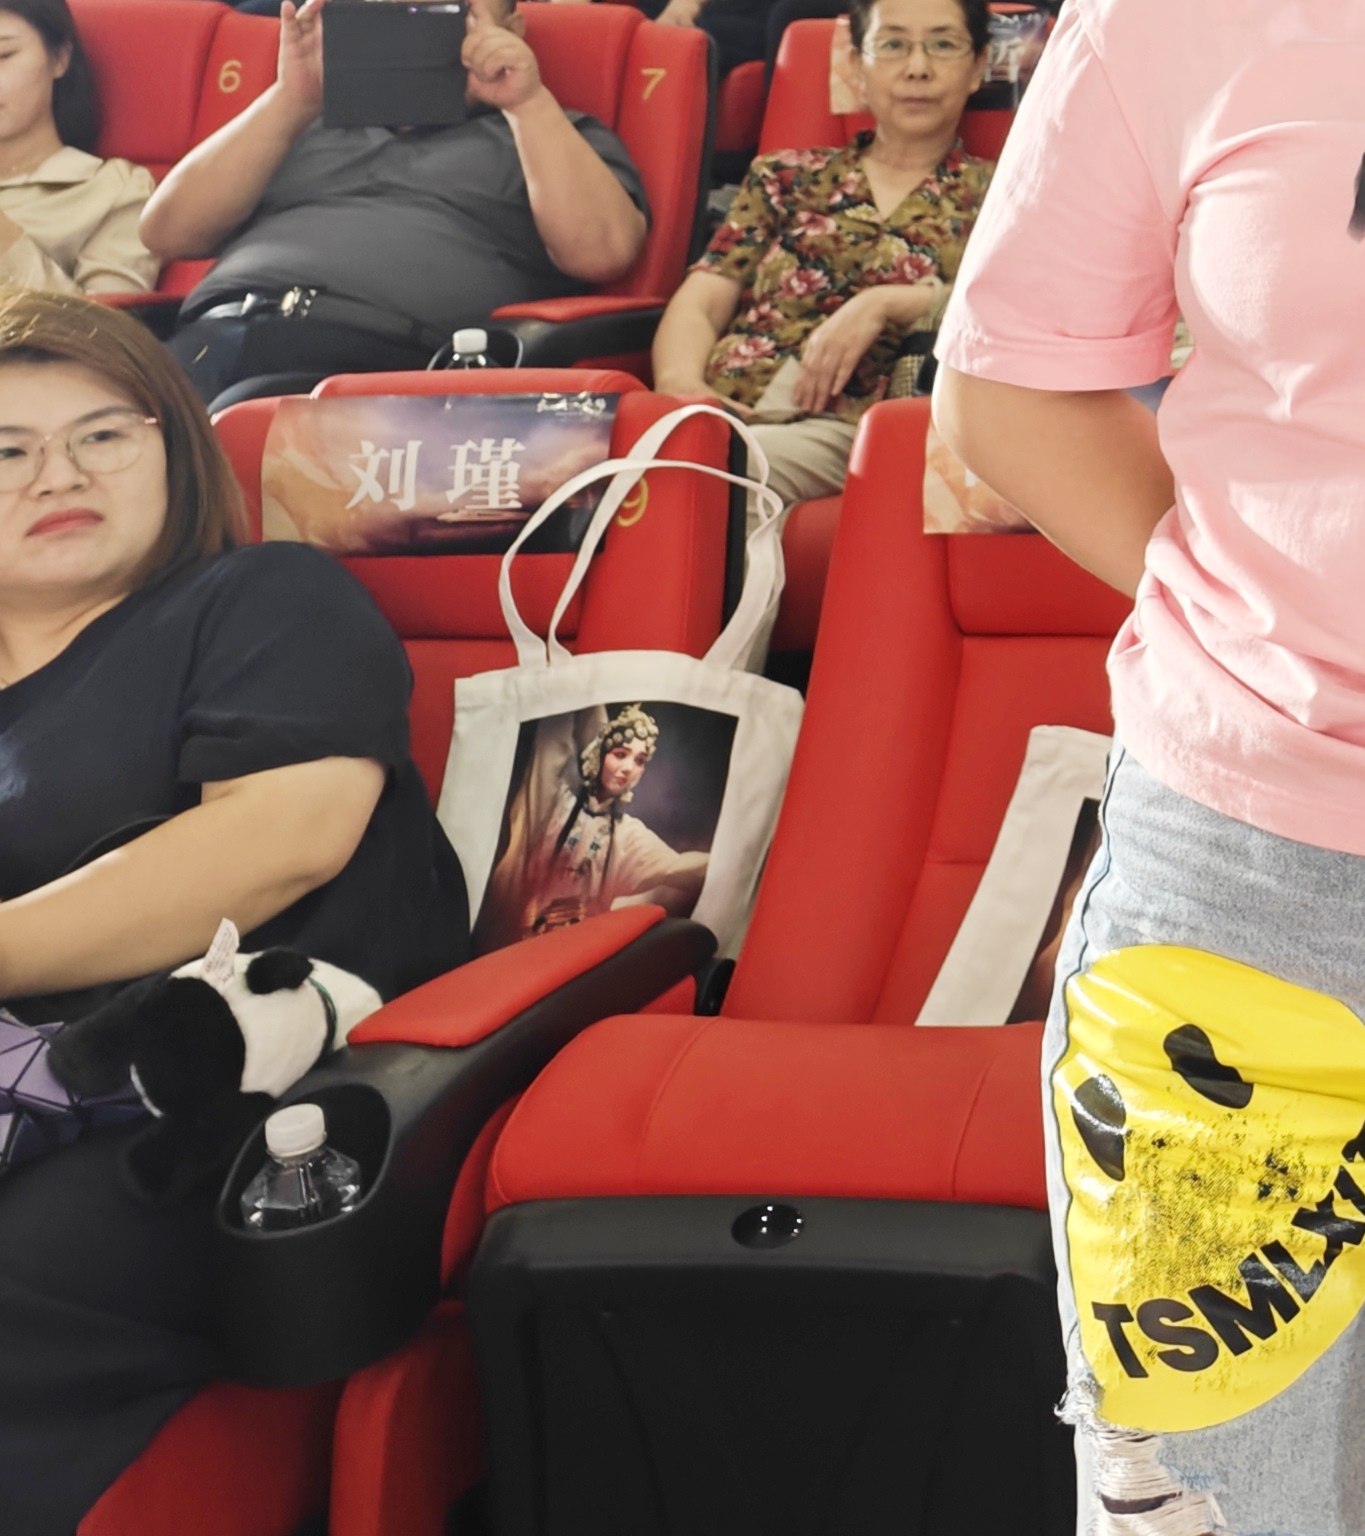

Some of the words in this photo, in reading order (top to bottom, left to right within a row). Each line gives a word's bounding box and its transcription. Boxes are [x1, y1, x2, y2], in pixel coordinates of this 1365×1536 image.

[219, 60, 242, 94] 6
[641, 67, 667, 100] 7
[345, 438, 526, 511] 刘瑾
[615, 476, 650, 527] 9
